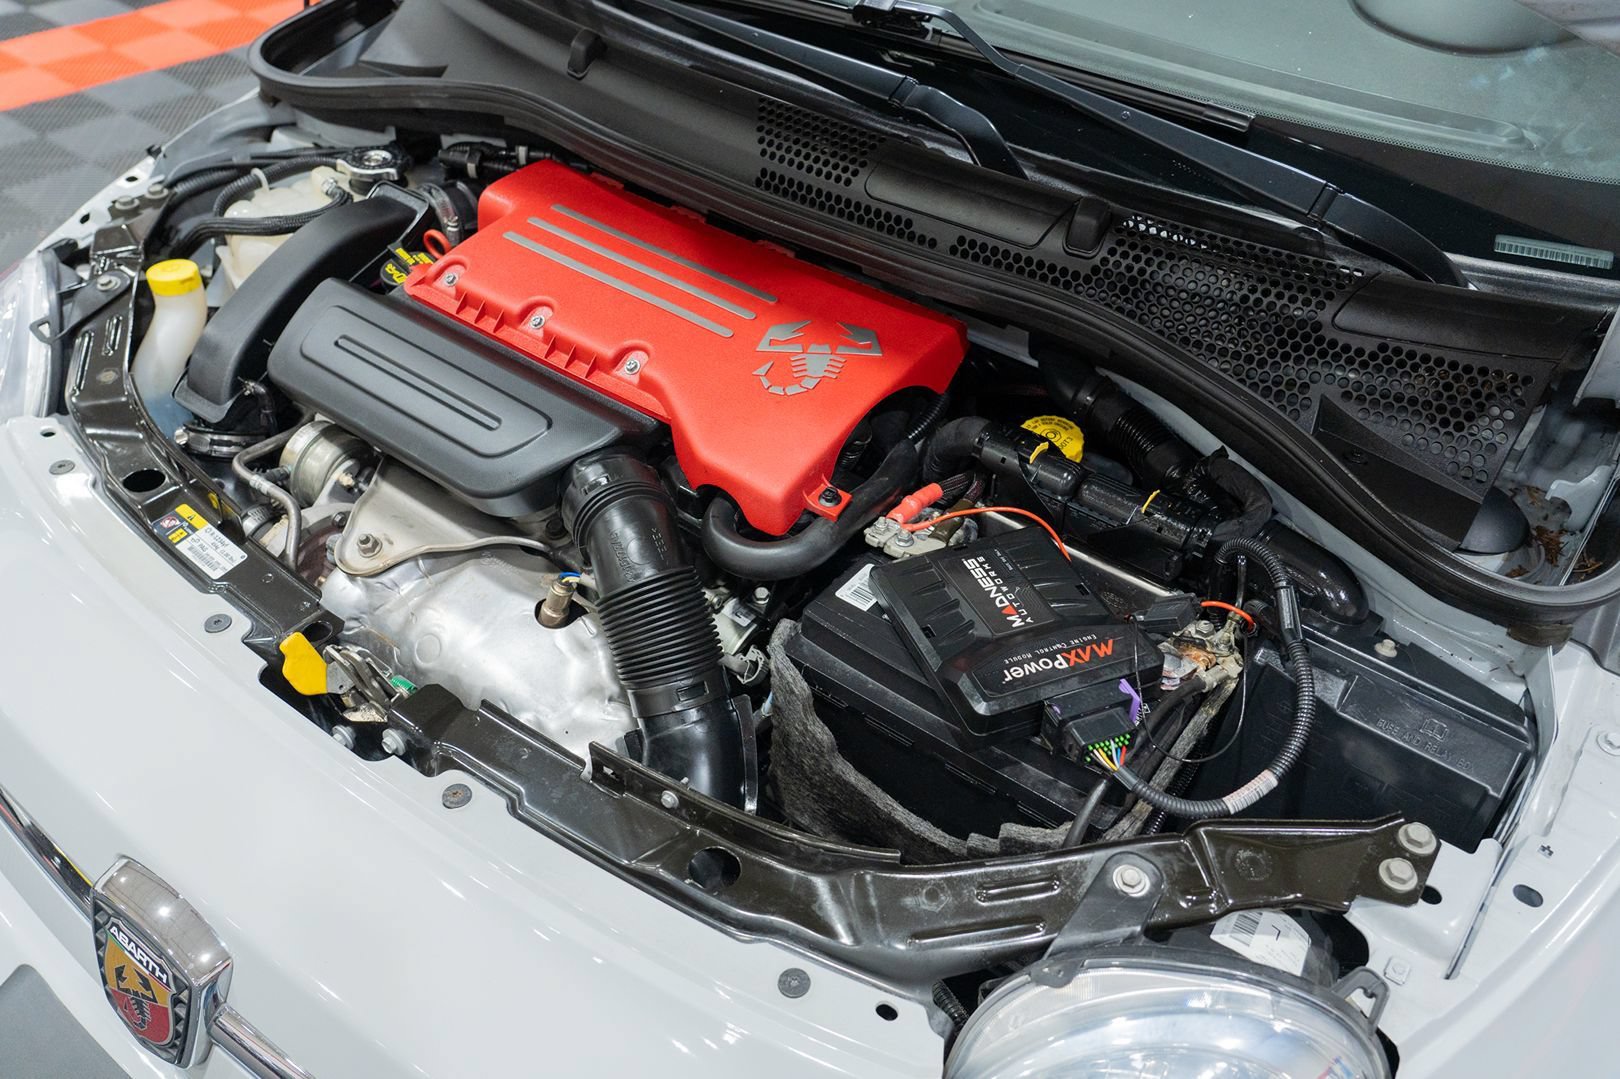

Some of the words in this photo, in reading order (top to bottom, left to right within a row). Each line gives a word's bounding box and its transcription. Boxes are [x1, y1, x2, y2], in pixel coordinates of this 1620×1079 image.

[961, 558, 1025, 627] MADNESS
[977, 556, 1034, 623] AUTOWORKS
[1004, 653, 1032, 664] MODULE
[1034, 642, 1067, 655] CONTROL
[1070, 634, 1097, 645] ENGINE
[1376, 718, 1400, 736] FUSE
[1402, 732, 1421, 746] AND
[1424, 742, 1452, 761] RELAY
[110, 926, 168, 984] ABARTH
